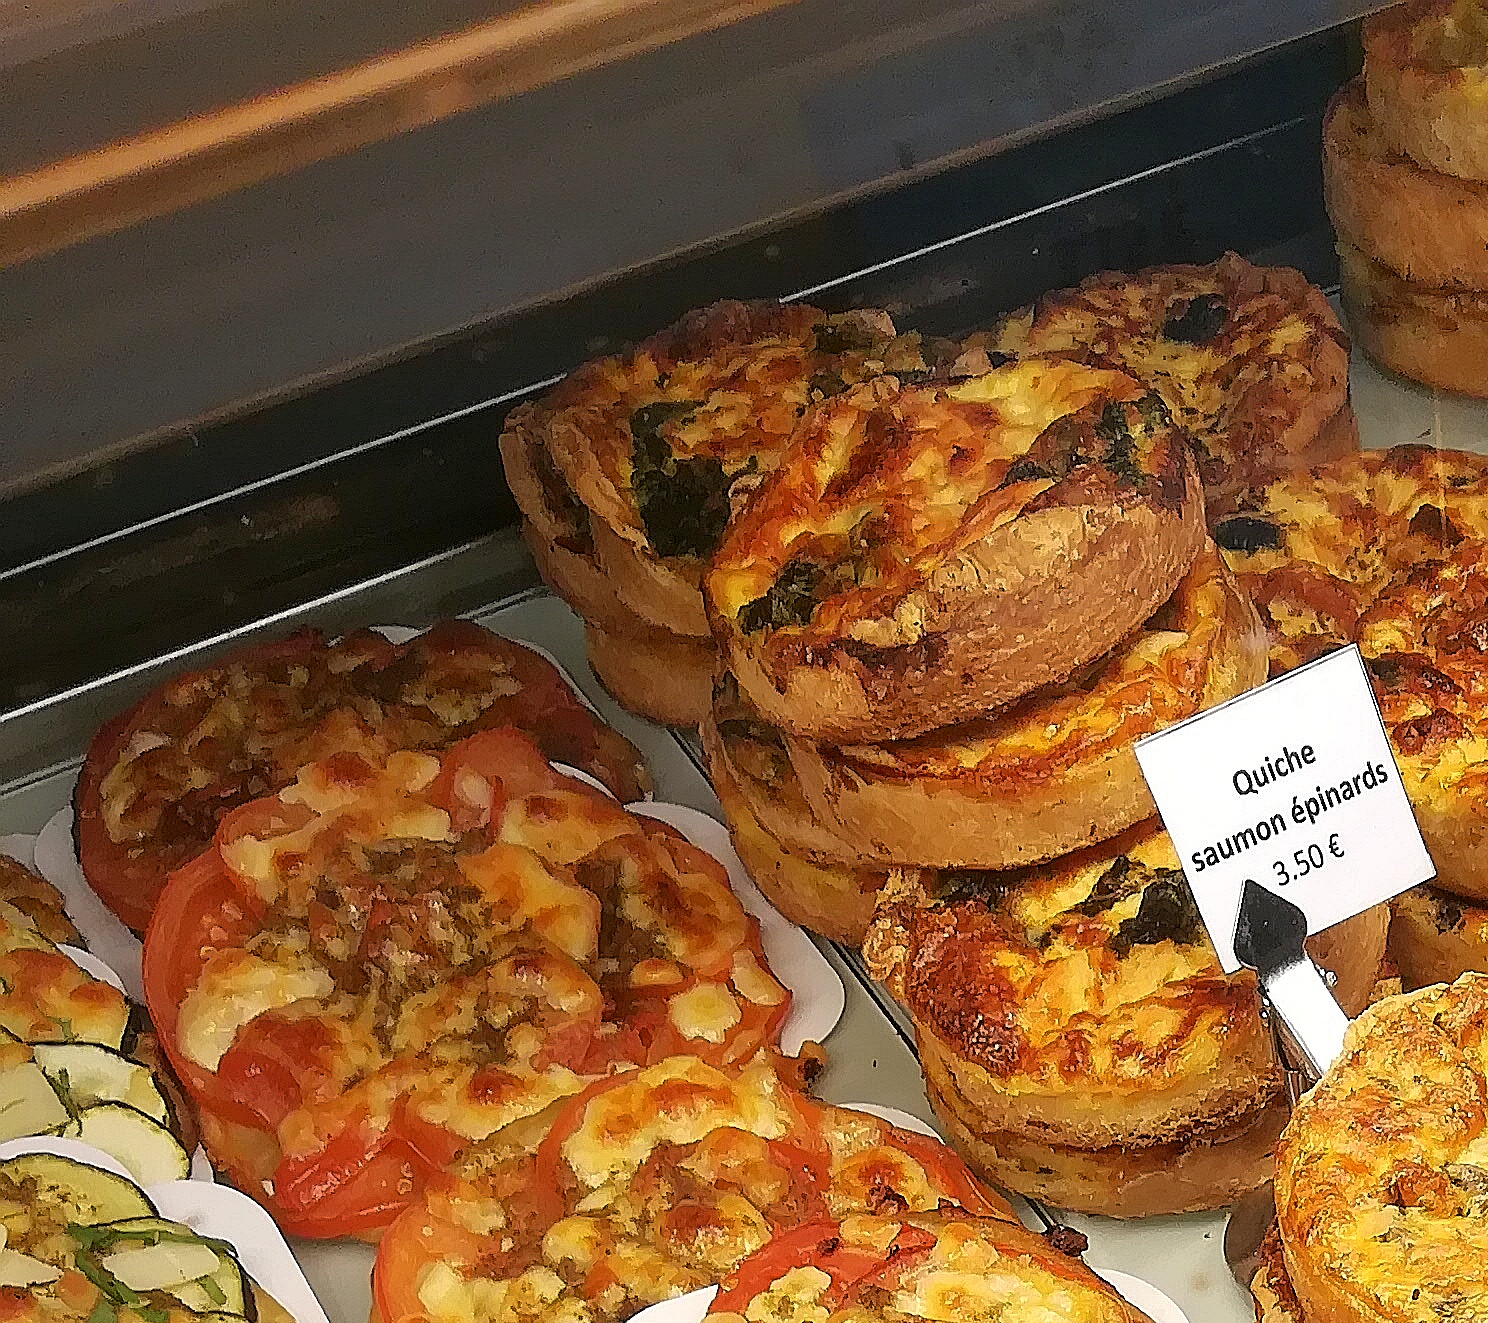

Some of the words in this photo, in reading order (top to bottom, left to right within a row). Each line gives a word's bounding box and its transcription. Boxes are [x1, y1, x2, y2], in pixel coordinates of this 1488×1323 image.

[1232, 744, 1317, 796] Quiche
[1191, 811, 1287, 872] saumon
[1291, 761, 1389, 825] épinards
[1272, 843, 1325, 886] 3.50
[1328, 833, 1345, 859] €
